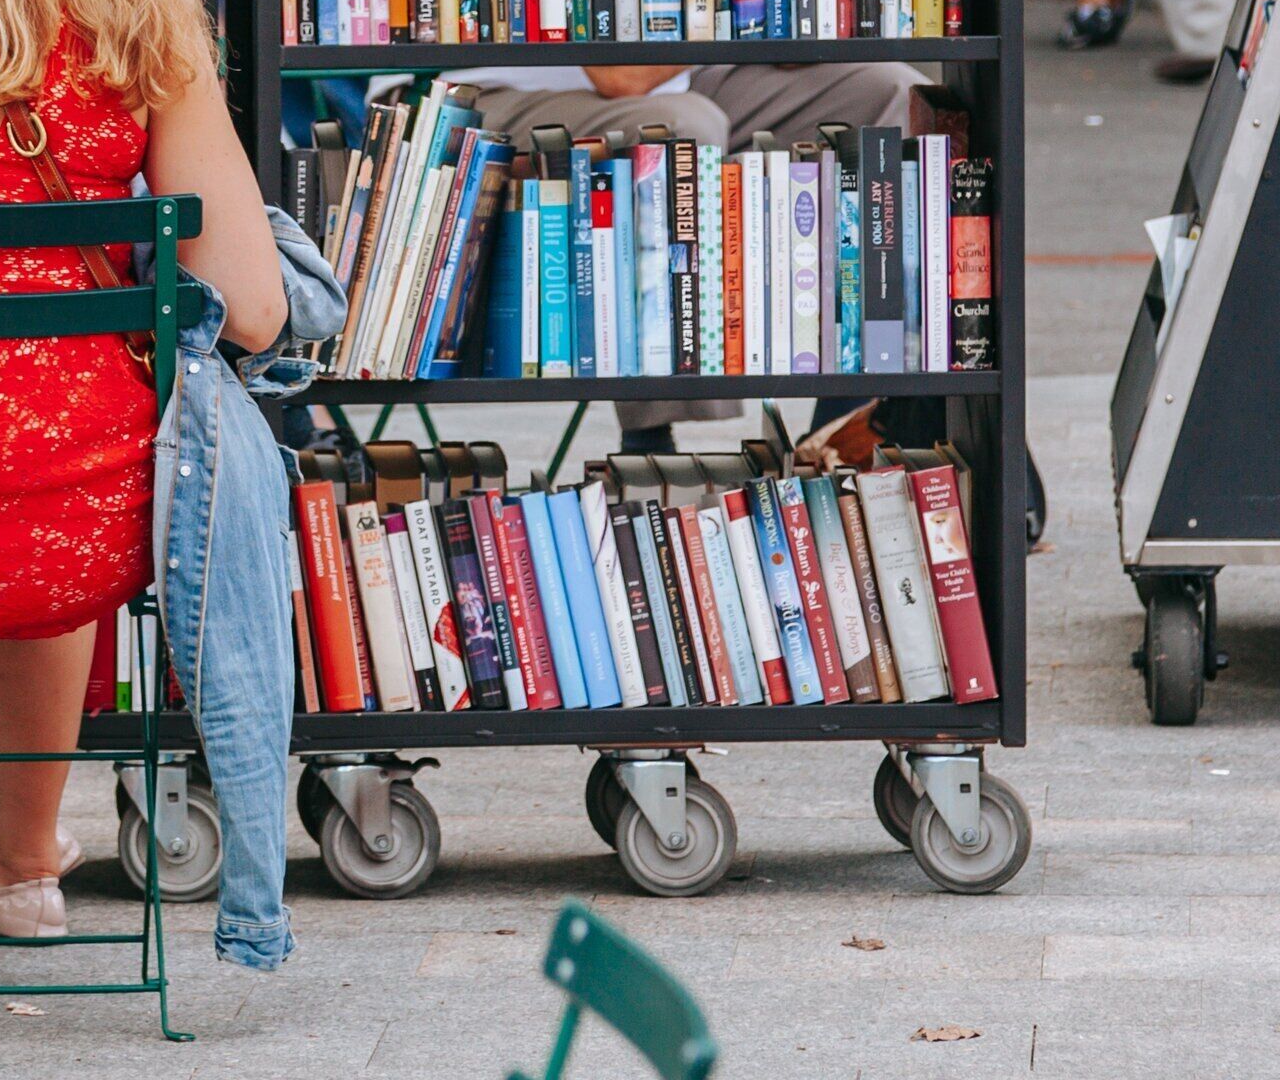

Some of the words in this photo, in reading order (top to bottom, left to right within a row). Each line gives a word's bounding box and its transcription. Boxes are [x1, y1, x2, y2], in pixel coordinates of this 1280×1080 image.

[297, 160, 307, 193] KELLY
[674, 142, 692, 178] LINDA
[650, 179, 665, 237] DAUGHTER
[727, 172, 737, 212] ELINOR
[871, 181, 882, 204] ART
[675, 182, 696, 242] FAIRSTEIN
[883, 181, 895, 244] AMERICAN
[728, 215, 738, 256] LIPMAN
[871, 220, 883, 245] 1900
[954, 261, 990, 273] Alliance
[956, 246, 986, 258] Grand
[544, 250, 567, 304] 2010
[576, 252, 584, 296] BARRETT
[583, 252, 593, 297] ANDREA
[729, 268, 739, 285] The
[681, 275, 692, 319] KILLER
[954, 304, 990, 317] Churchill
[682, 320, 693, 353] HEAT
[730, 316, 741, 340] Man
[305, 499, 320, 533] Andrea
[755, 481, 774, 518] SWORD
[788, 506, 801, 524] The
[318, 510, 331, 536] selected
[413, 507, 428, 541] BOAT
[648, 503, 665, 543] STEGNER
[763, 517, 781, 547] SONG
[845, 502, 869, 569] WHEREVER
[310, 533, 328, 577] Zanzotto
[322, 536, 335, 559] poetry
[788, 522, 818, 577] Sultan's
[827, 541, 844, 564] Big
[326, 559, 337, 573] and
[327, 573, 340, 592] prose
[420, 546, 442, 606] BASTARD
[832, 563, 851, 594] Dogs
[773, 569, 799, 620] Bernard
[801, 576, 825, 610] Seal
[860, 570, 877, 600] YOU
[495, 604, 509, 631] God's
[866, 601, 882, 624] GO
[500, 631, 516, 666] Silence
[516, 626, 531, 663] ELECTION
[614, 620, 629, 650] WARD
[784, 620, 812, 677] Cornwell
[842, 613, 864, 656] Flyboys
[620, 650, 634, 675] JUST
[679, 644, 691, 665] head
[822, 650, 835, 675] WHITE
[522, 663, 537, 695] DEADLY
